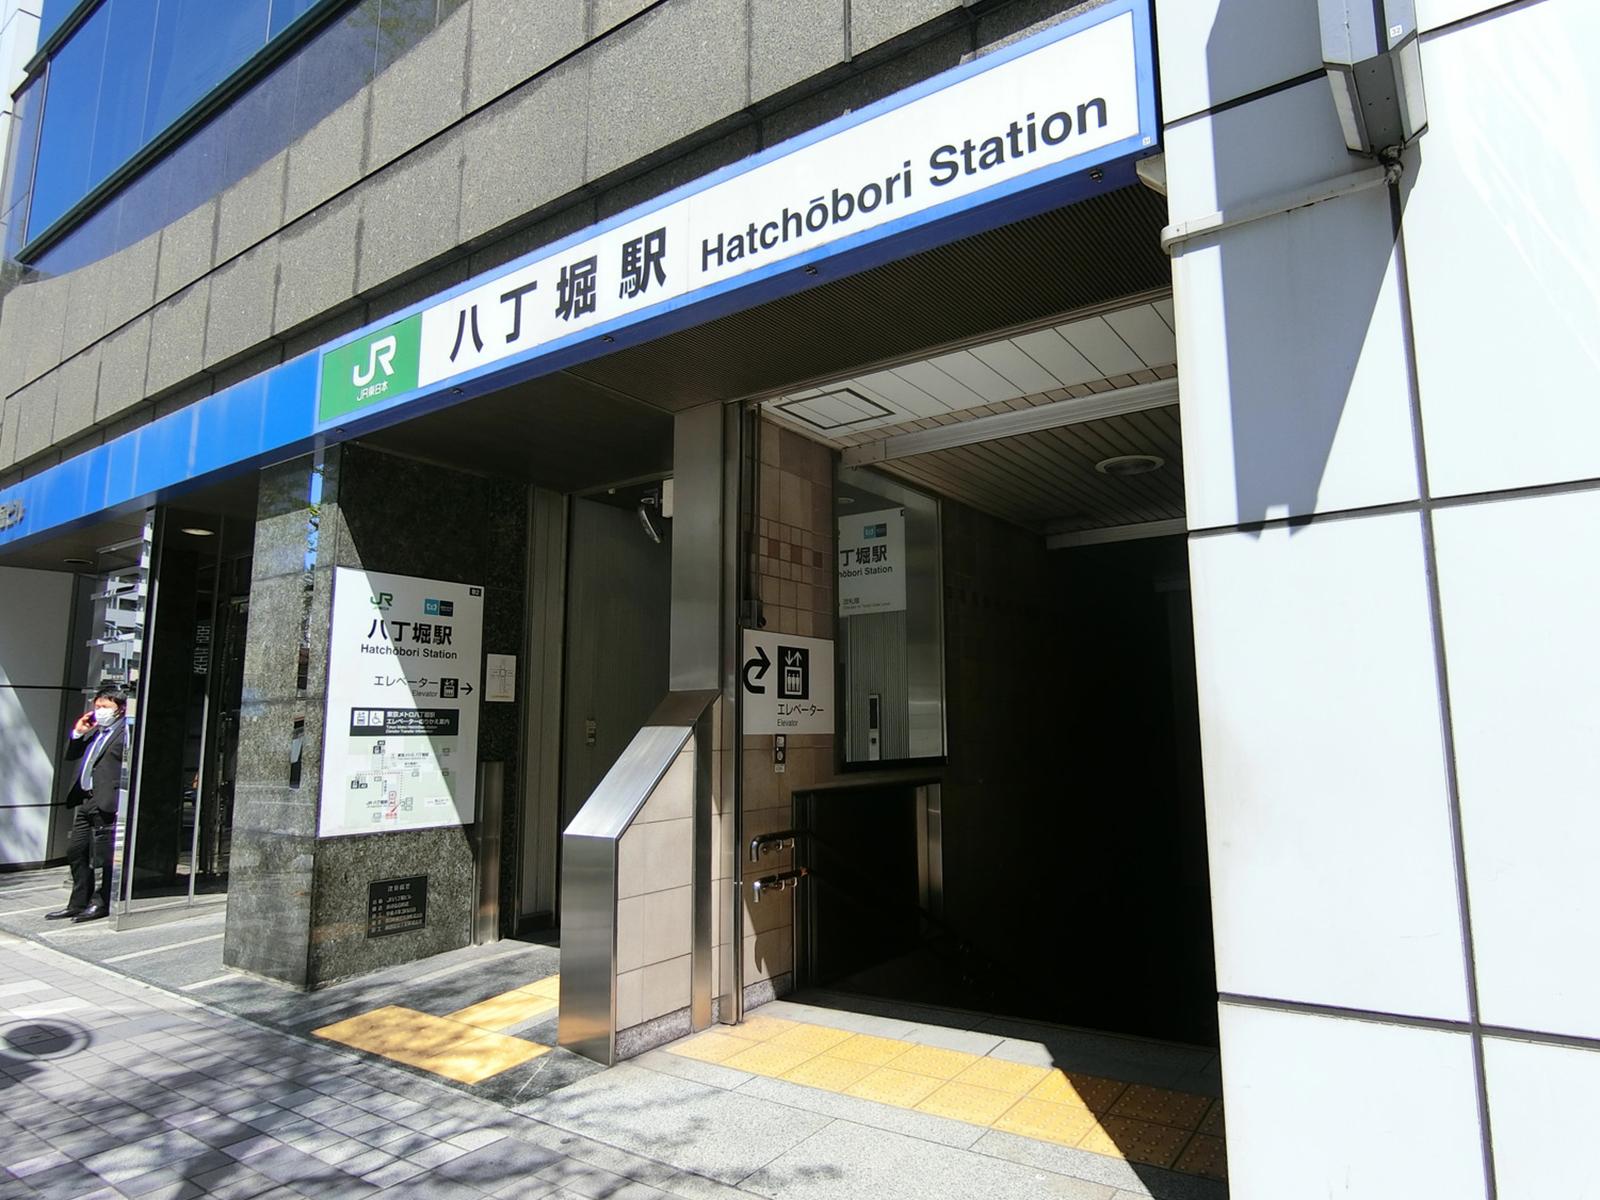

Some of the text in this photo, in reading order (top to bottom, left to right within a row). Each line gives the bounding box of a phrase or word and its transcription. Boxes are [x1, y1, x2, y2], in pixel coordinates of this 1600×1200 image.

[701, 97, 1108, 272] Hatchōbori Station
[449, 227, 667, 362] 八丁堀駅
[352, 335, 396, 386] JR
[356, 380, 389, 402] JR東日本
[840, 544, 887, 567] 丁堀駅
[839, 565, 893, 578] ōbori Station
[370, 592, 393, 607] JR
[367, 619, 452, 645] 八丁堀駅
[361, 644, 458, 660] Hatchōbori Station
[374, 675, 439, 688] エレベーター
[412, 690, 438, 698] Elevator
[777, 703, 824, 717] エレベーター
[776, 719, 799, 727] Elevator
